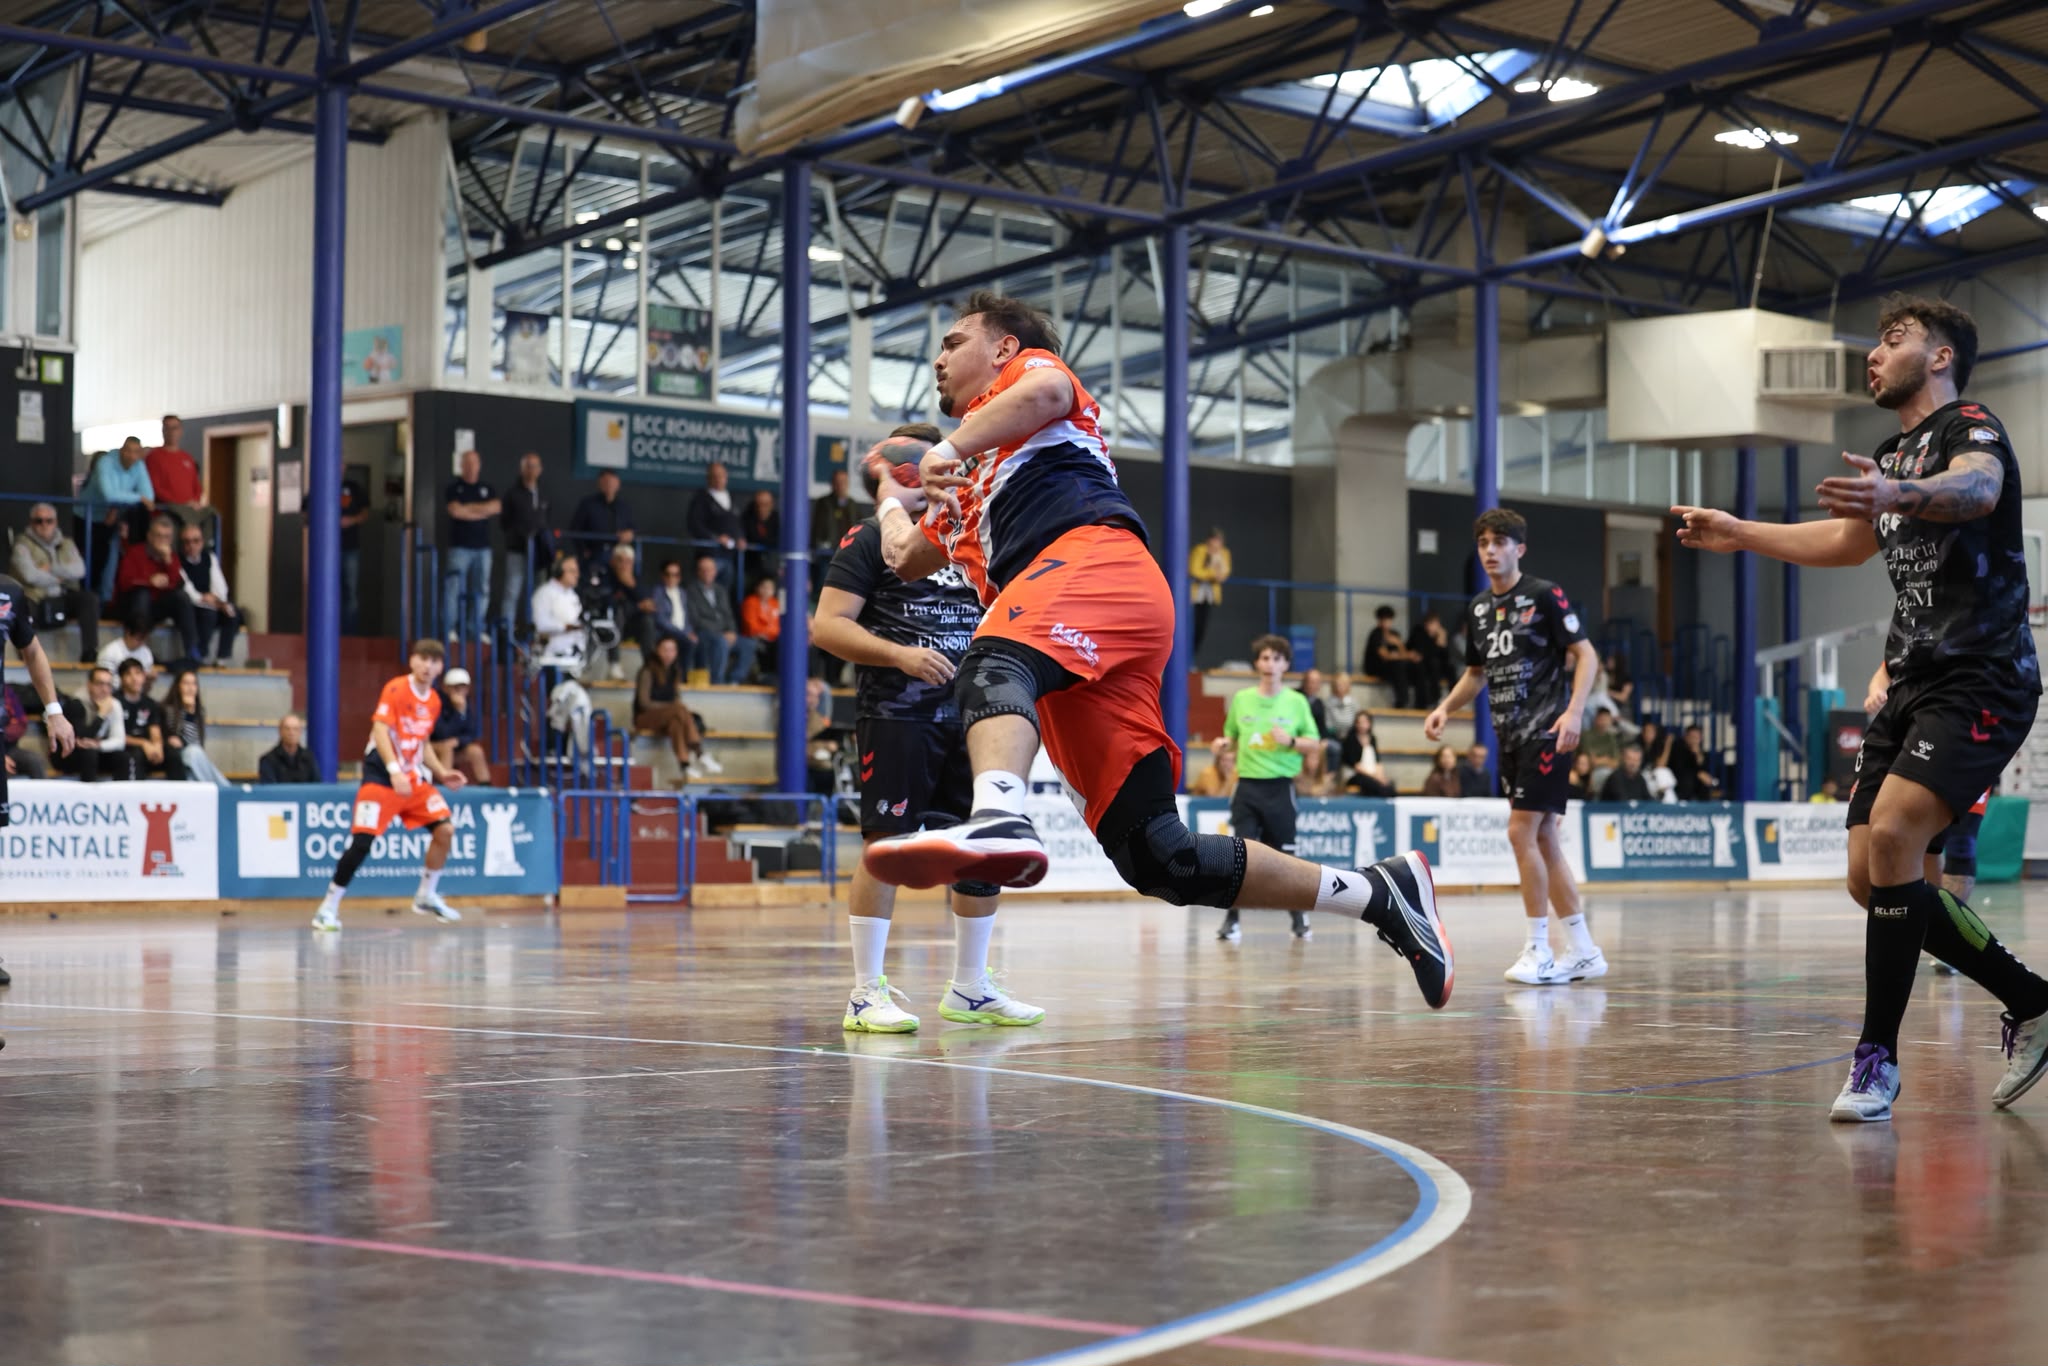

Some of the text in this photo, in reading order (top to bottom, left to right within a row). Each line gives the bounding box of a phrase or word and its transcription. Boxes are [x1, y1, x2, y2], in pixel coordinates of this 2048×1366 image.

[632, 414, 750, 445] BCC ROMAGNA
[632, 436, 749, 466] OCCIDENTALE
[1025, 558, 1067, 581] 7
[1486, 629, 1514, 659] 20
[8, 802, 130, 826] OMAGNA
[305, 801, 351, 829] BCC
[1295, 811, 1352, 833] MAGNA
[1623, 814, 1711, 834] BCC ROMAGNA
[1623, 835, 1712, 856] OCCIDENTALE
[1874, 906, 1909, 916] SELECT
